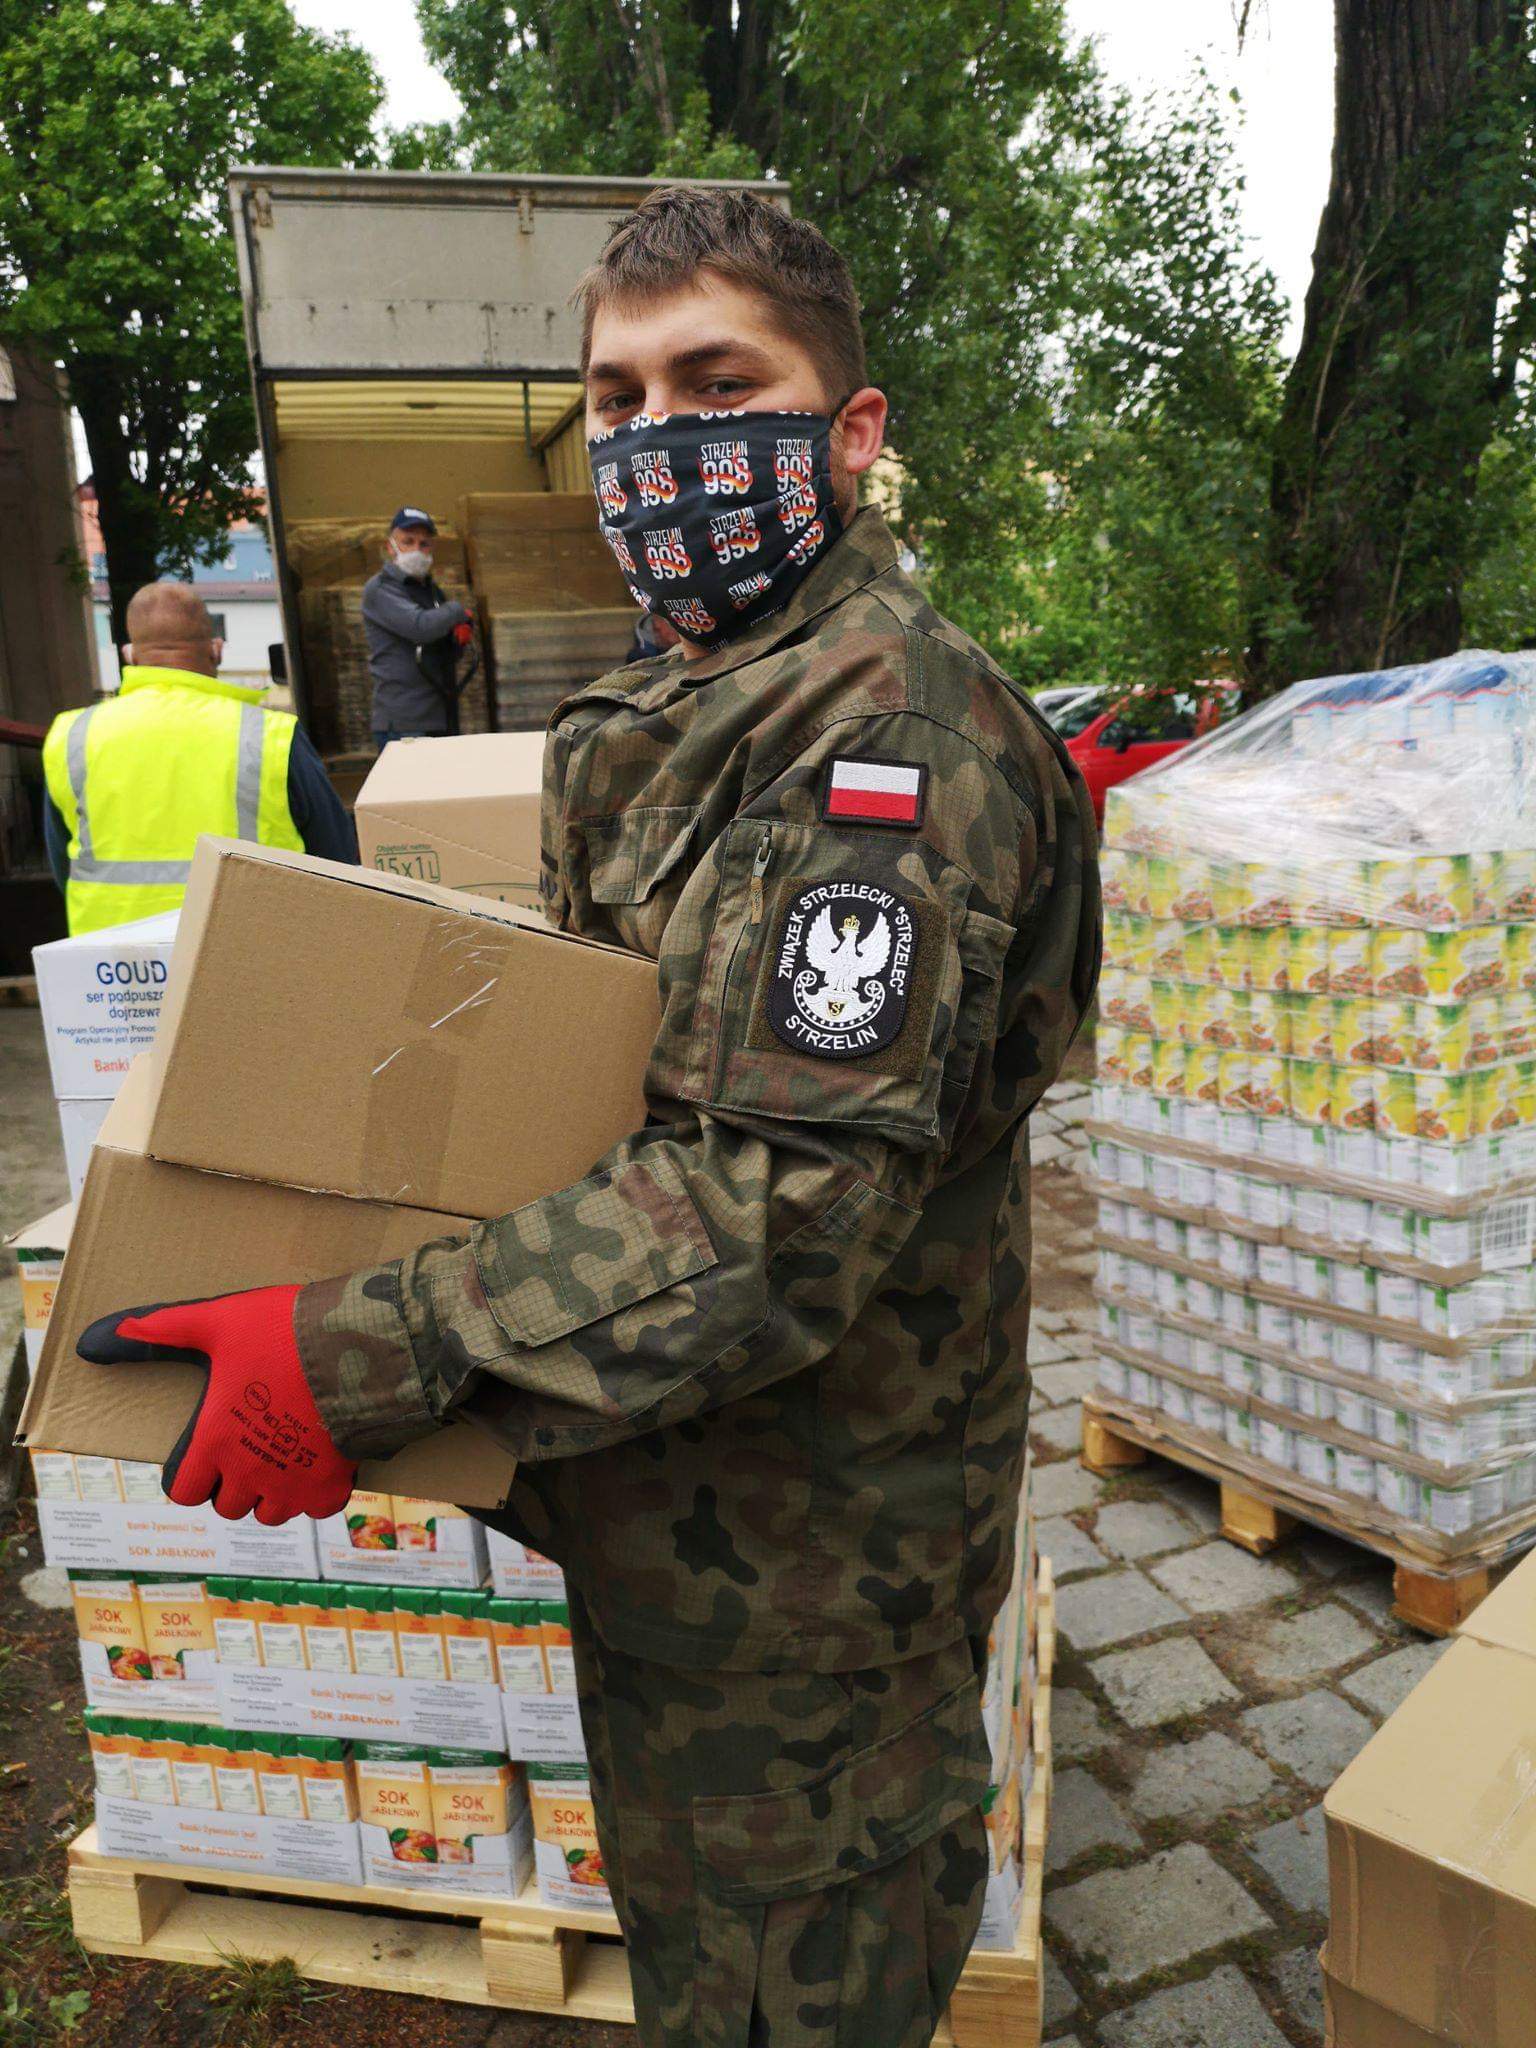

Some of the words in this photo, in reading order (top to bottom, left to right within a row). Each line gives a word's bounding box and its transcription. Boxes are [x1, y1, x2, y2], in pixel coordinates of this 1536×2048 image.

[631, 449, 670, 472] STRZELIN
[701, 440, 748, 460] STRZELIN
[702, 457, 751, 495] 998
[634, 467, 677, 508] 998
[709, 506, 756, 534] STRZELIN
[642, 526, 683, 546] STRZELIN
[713, 521, 761, 565] 998
[646, 543, 692, 580] 998
[778, 911, 806, 980] ZWIĄZEK
[800, 883, 896, 911] STRZELECKI
[86, 992, 104, 1004] ser
[786, 1014, 879, 1051] STRZELIN
[95, 1608, 123, 1624] SOK
[161, 1611, 193, 1627] SOK
[378, 1789, 411, 1806] SOK
[452, 1794, 486, 1810] SOK
[553, 1809, 588, 1825] SOK
